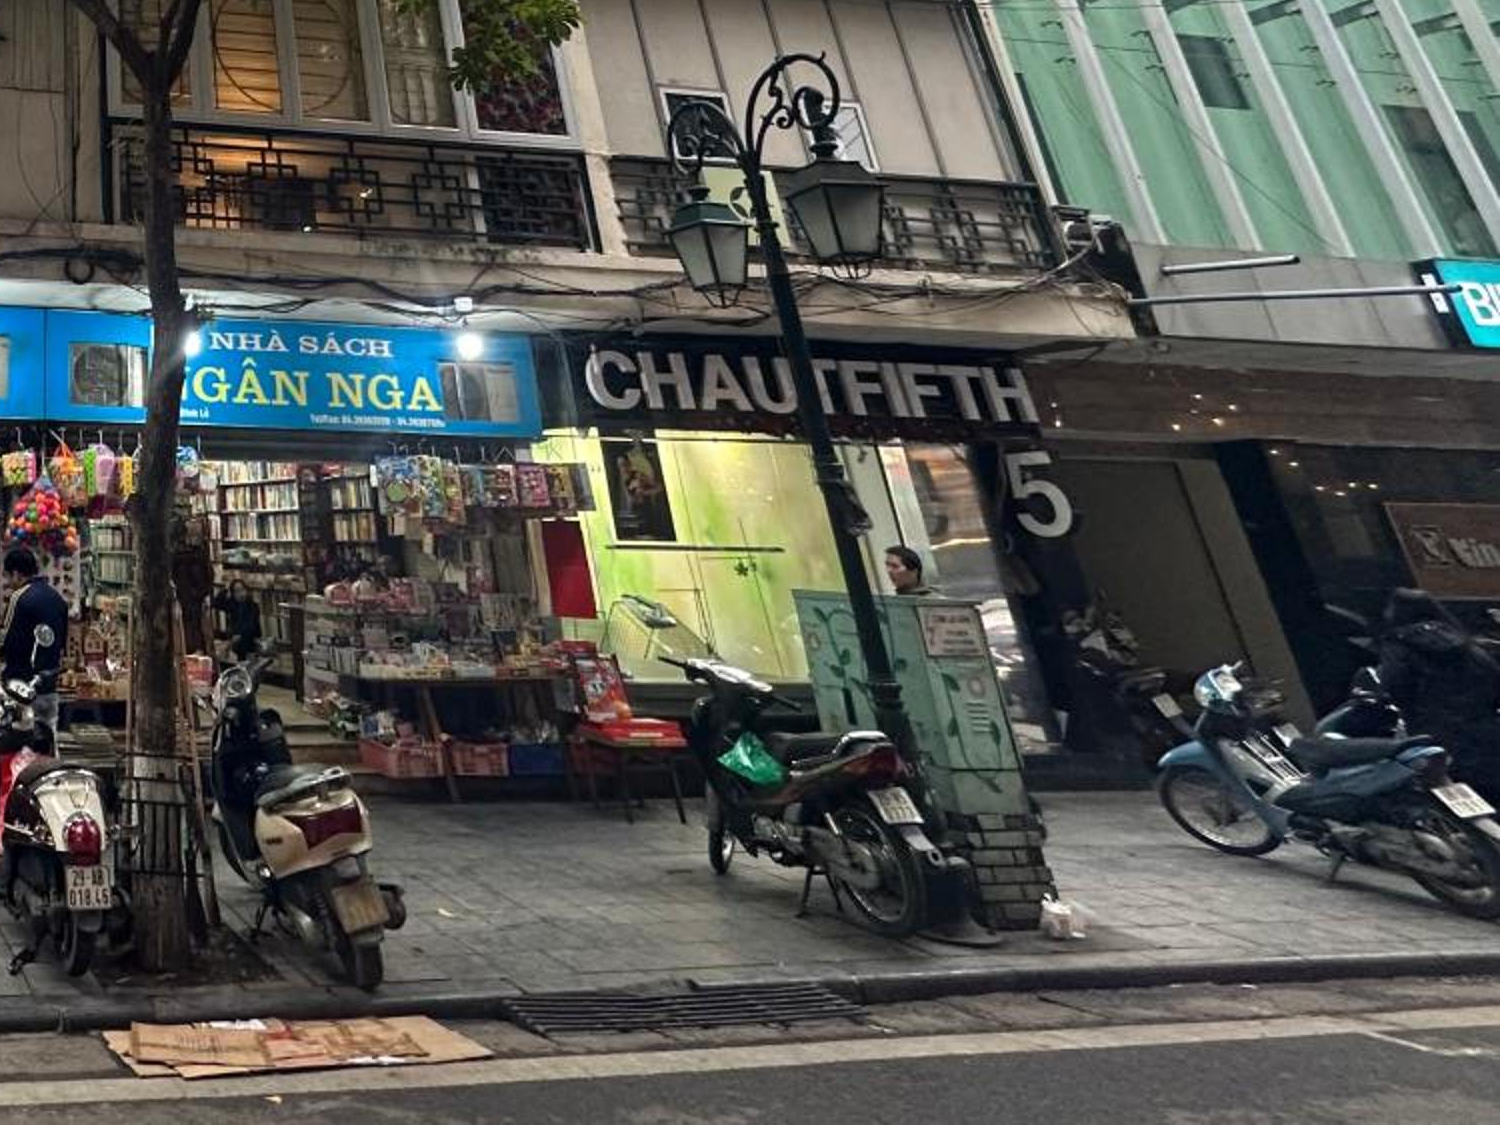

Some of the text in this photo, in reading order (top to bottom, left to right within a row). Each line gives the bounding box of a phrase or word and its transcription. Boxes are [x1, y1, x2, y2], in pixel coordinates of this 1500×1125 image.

[209, 329, 394, 358] NHÀ SÁCH
[326, 371, 444, 412] NGA
[1005, 450, 1075, 538] 5
